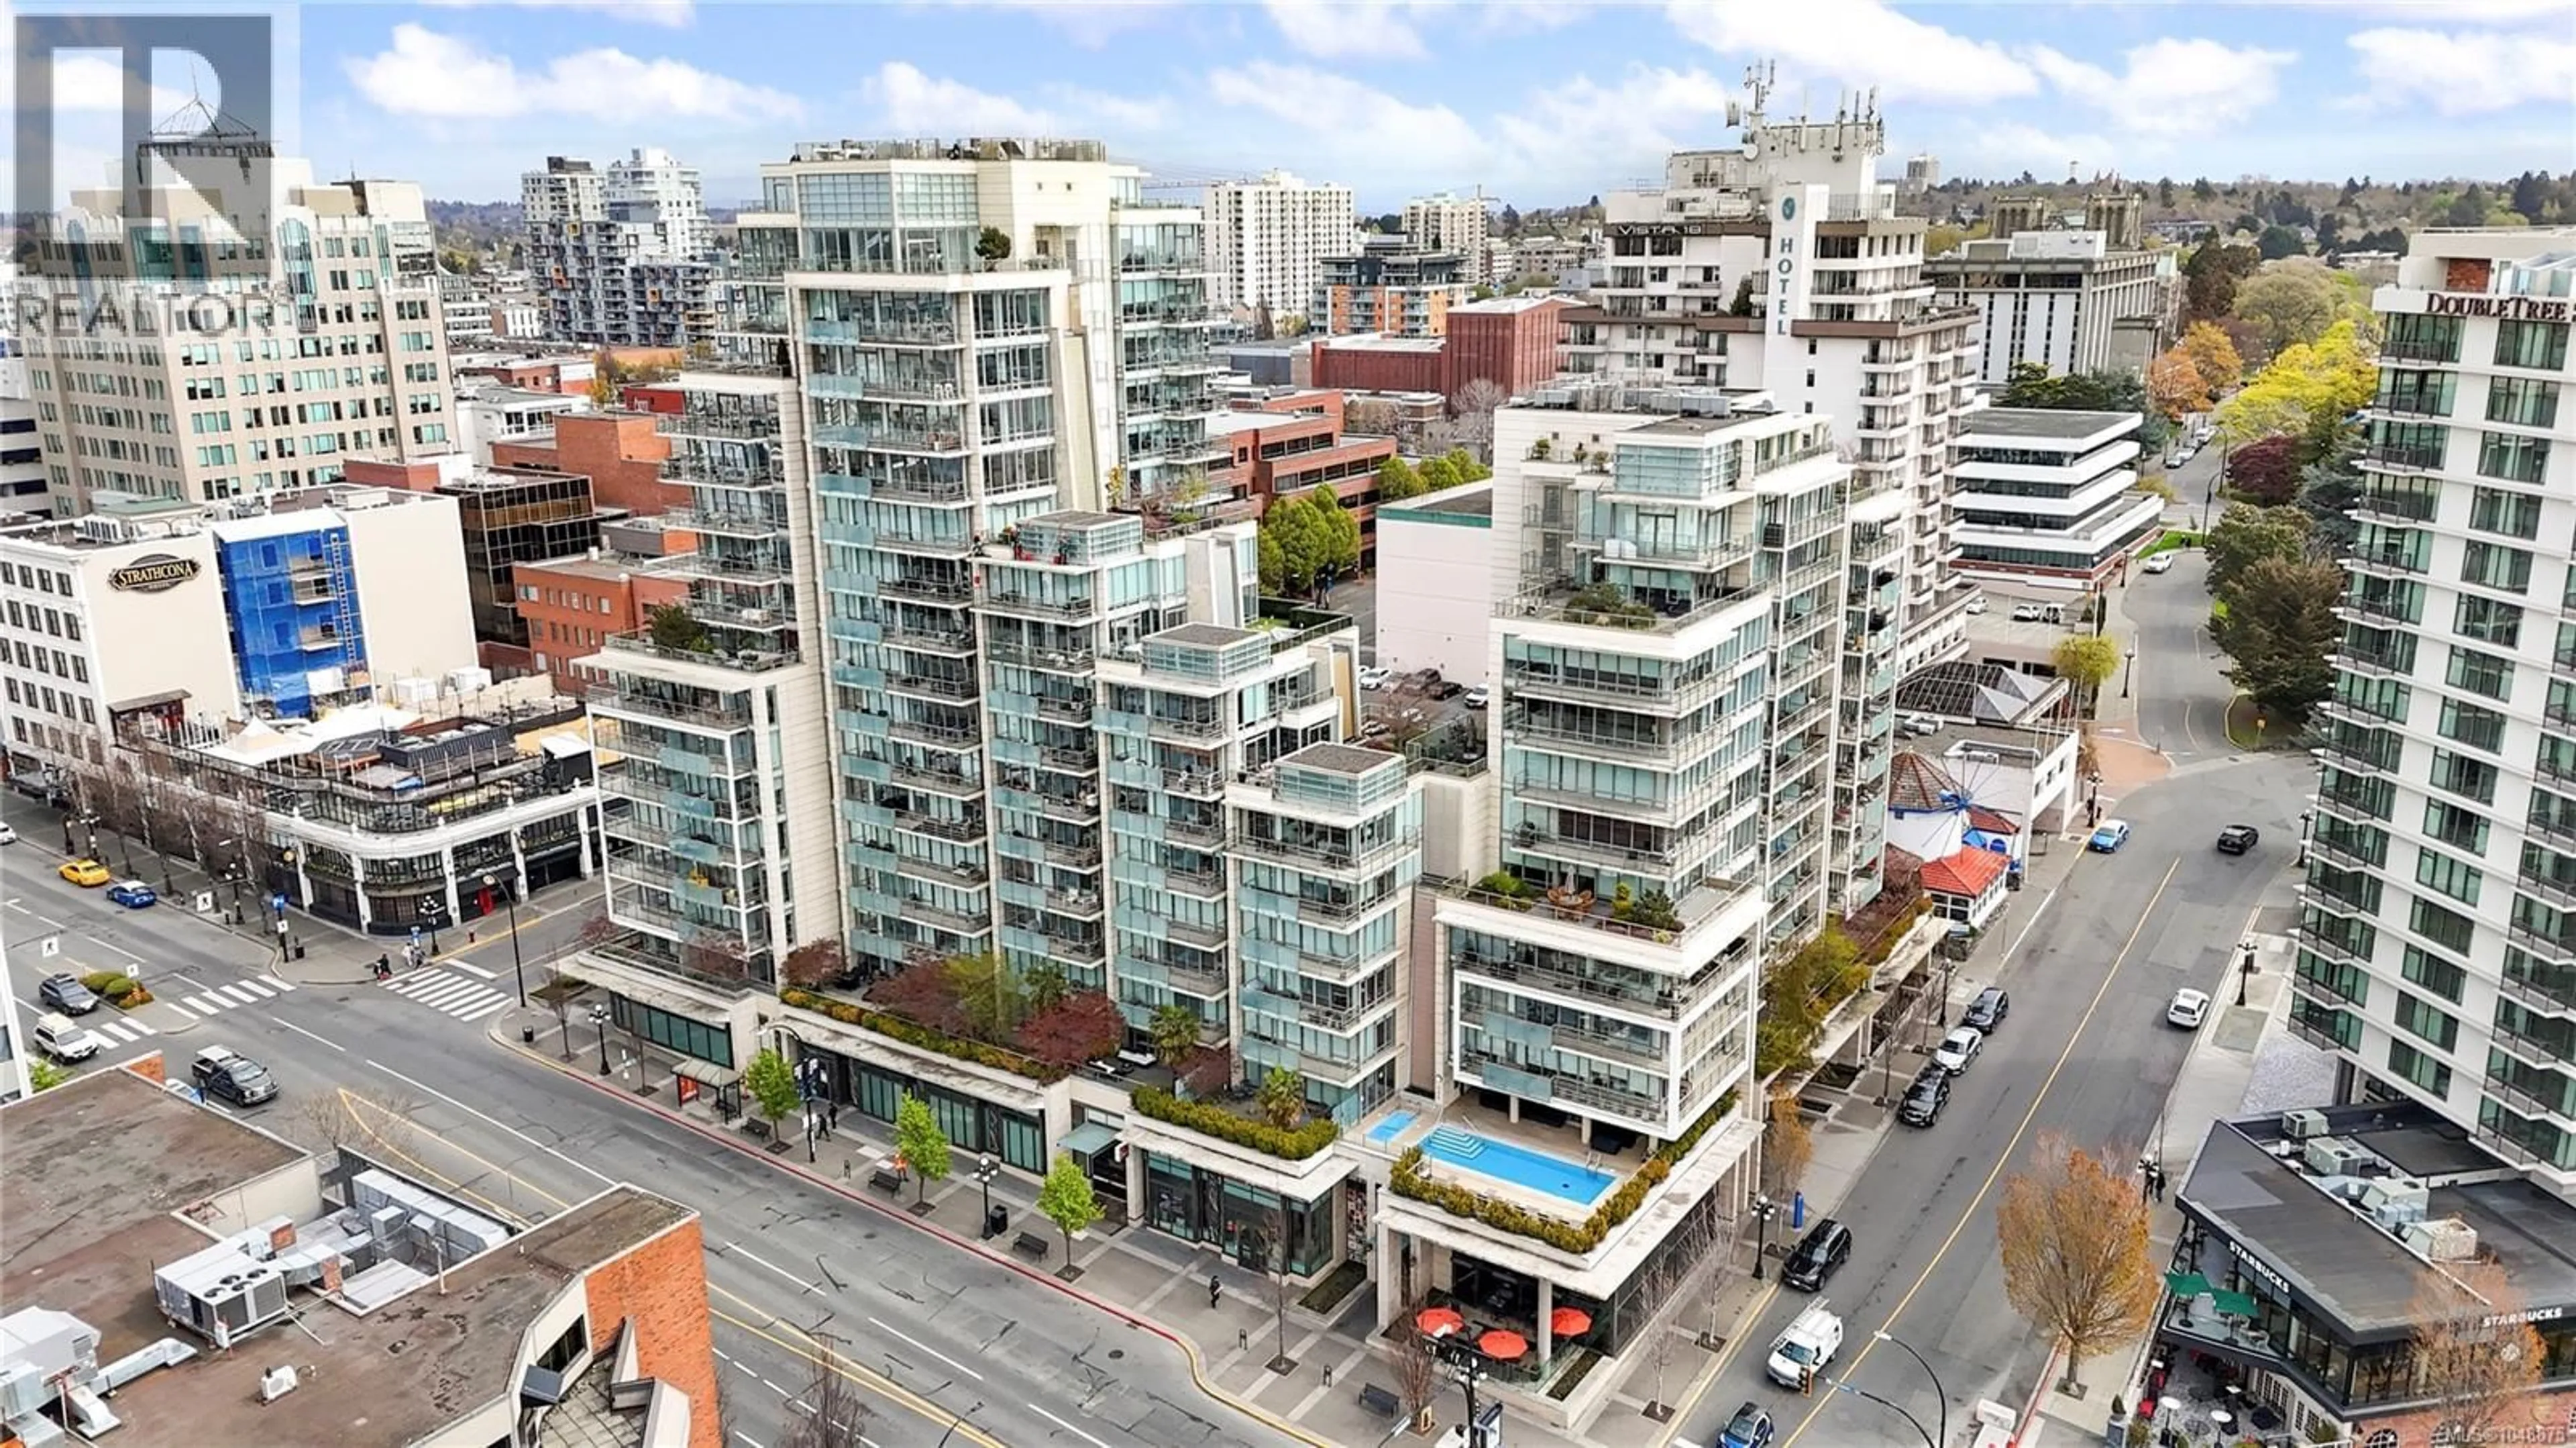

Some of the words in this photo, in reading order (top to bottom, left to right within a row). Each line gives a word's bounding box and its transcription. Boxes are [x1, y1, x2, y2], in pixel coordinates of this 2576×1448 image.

[1777, 238, 1793, 335] HOTEL
[118, 561, 193, 585] STRATHCONA
[2229, 1241, 2290, 1293] STARBUCKS
[2483, 1307, 2563, 1328] STARBUCKS
